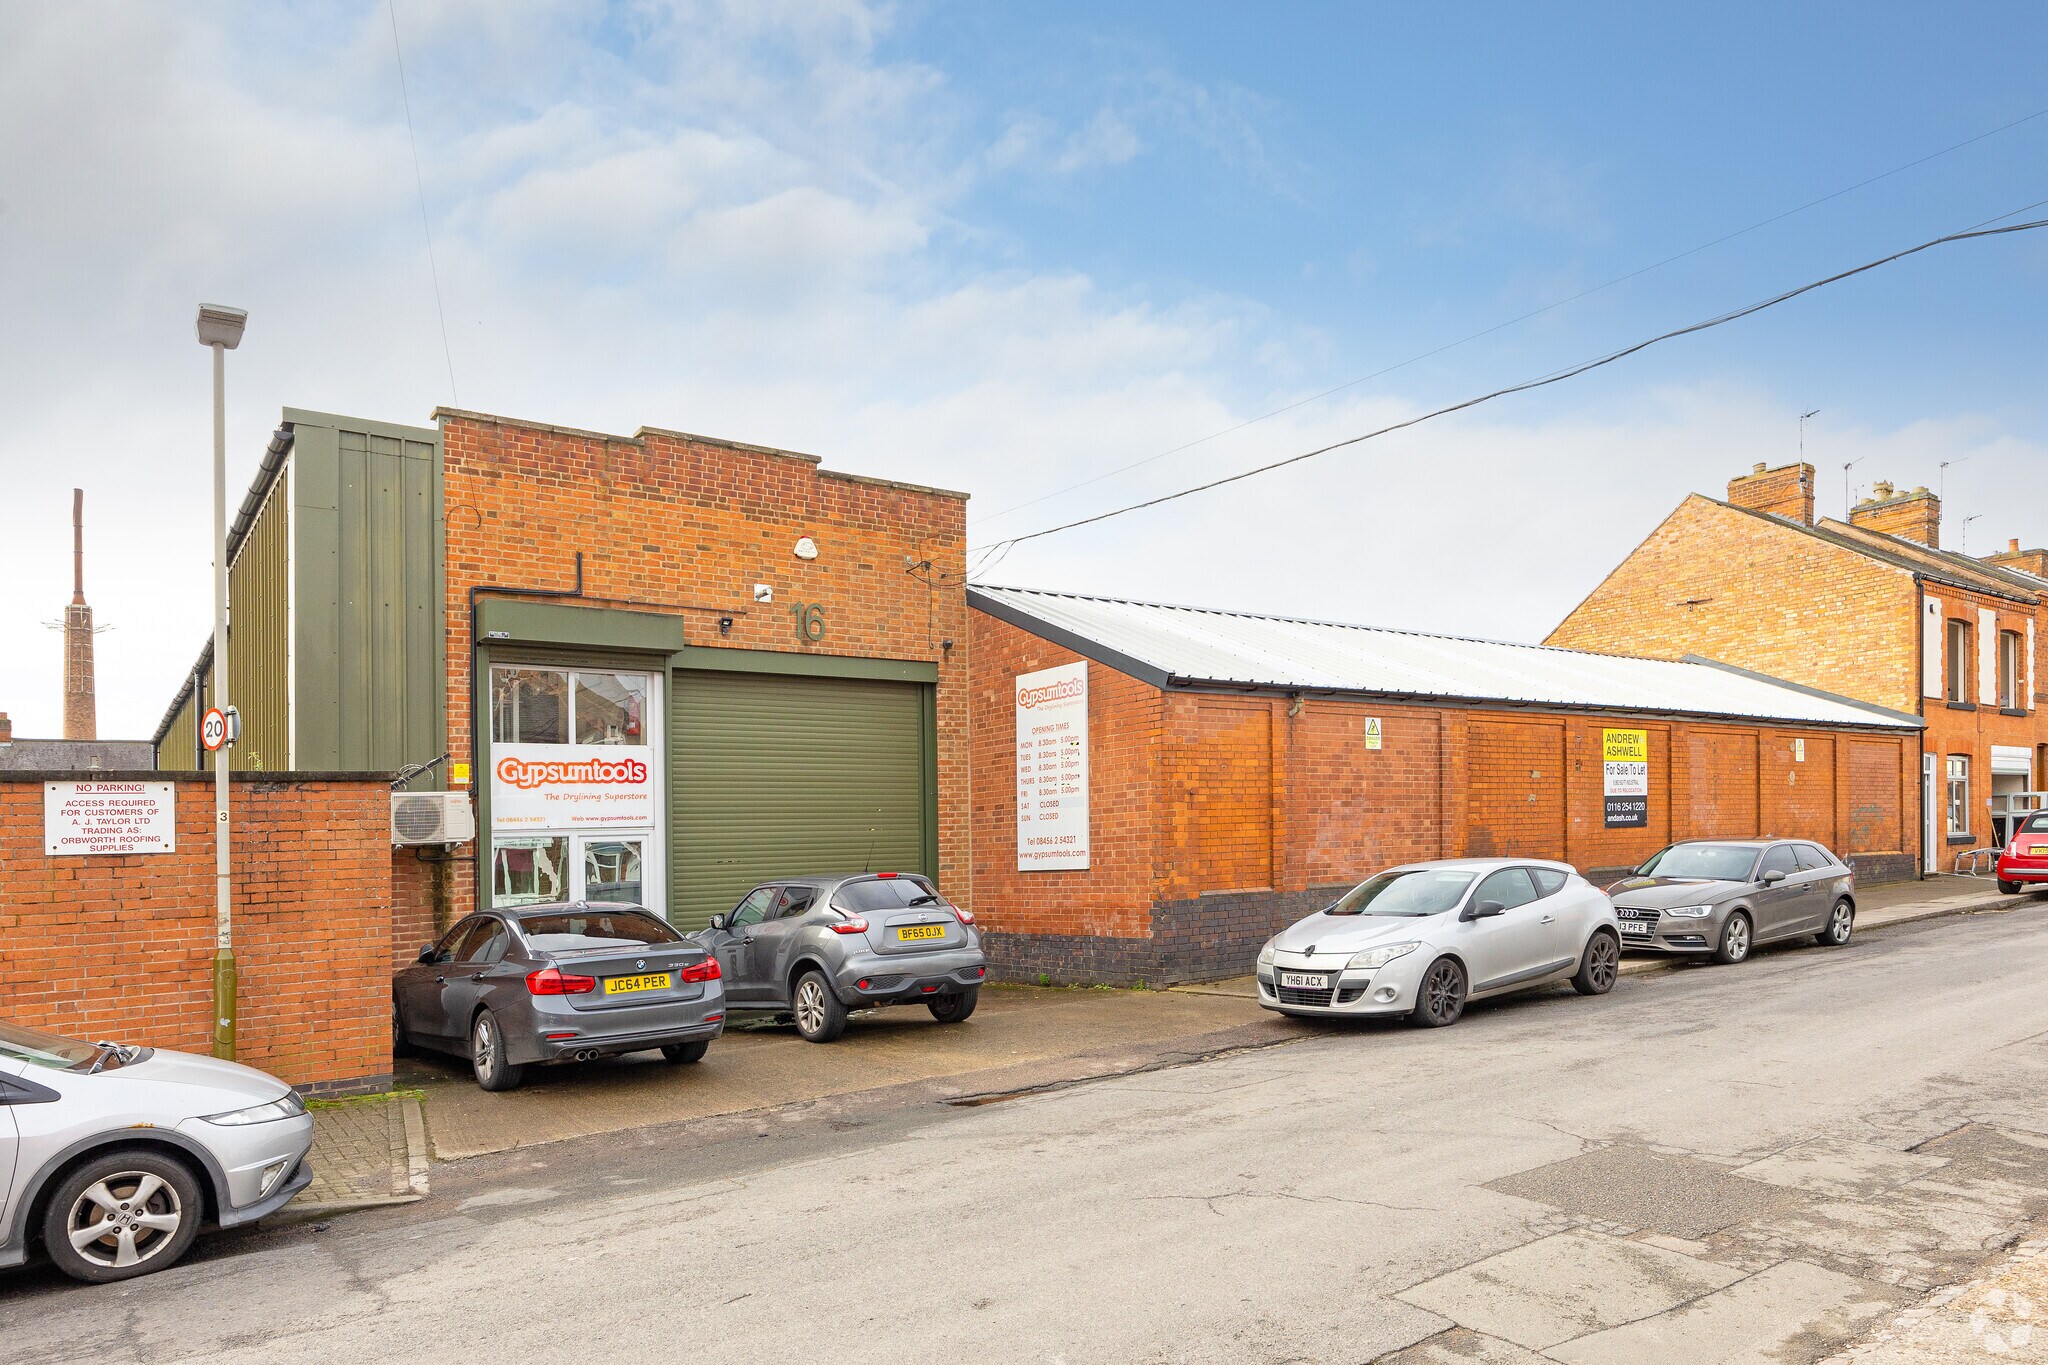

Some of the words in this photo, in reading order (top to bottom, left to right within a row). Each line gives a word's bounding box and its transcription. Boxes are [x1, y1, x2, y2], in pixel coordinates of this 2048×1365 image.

[790, 601, 826, 641] 16
[1018, 678, 1084, 709] Gypsumtools
[205, 720, 223, 738] 20
[1031, 724, 1055, 734] OPENING
[1055, 722, 1070, 731] TIMES
[1038, 739, 1057, 747] 8.30am
[1606, 733, 1640, 744] ANDREW
[1038, 751, 1057, 759] 8.30am
[1061, 748, 1079, 756] 5.00pm
[1606, 746, 1642, 757] ASHWELL
[1061, 761, 1079, 769] 5.00pm
[1606, 763, 1615, 776] For
[1637, 764, 1646, 776] Let
[497, 757, 648, 789] Gypsumtools
[1038, 776, 1057, 784] 8.30am
[1061, 773, 1080, 781] 5.00pm
[76, 784, 92, 792] NO
[97, 784, 145, 792] PARKING!
[1039, 788, 1057, 796] 8.30am
[1061, 786, 1080, 794] 5.00pm
[544, 793, 560, 801] The
[563, 792, 601, 802] Drylining
[604, 792, 648, 802] Superstore
[108, 799, 156, 807] REQUIRED
[1039, 800, 1060, 808] CLOSED
[1606, 802, 1621, 812] 0116
[1621, 802, 1632, 811] 254
[1632, 801, 1646, 811] 1220
[60, 809, 81, 817] FOR
[220, 812, 228, 821] 3
[1039, 812, 1059, 821] CLOSED
[134, 817, 151, 825] LTD
[585, 815, 648, 824] www.gypsumtools.com
[81, 827, 123, 835] TRADING
[61, 837, 116, 845] ORBWORTH
[119, 835, 161, 843] ROOFING
[1027, 838, 1036, 846] Tel
[1036, 837, 1053, 845] 08456
[1054, 836, 1059, 845] 2
[1059, 835, 1076, 844] 54321
[89, 844, 134, 852] SUPPLIES
[1019, 849, 1086, 860] www.gypsumtools.com
[1628, 923, 1644, 932] PFE
[902, 927, 924, 939] BF65
[925, 927, 943, 937] OJX
[610, 978, 641, 992] JC64
[643, 975, 666, 988] PER
[1285, 975, 1304, 986] YH61
[1305, 976, 1323, 987] ACX
